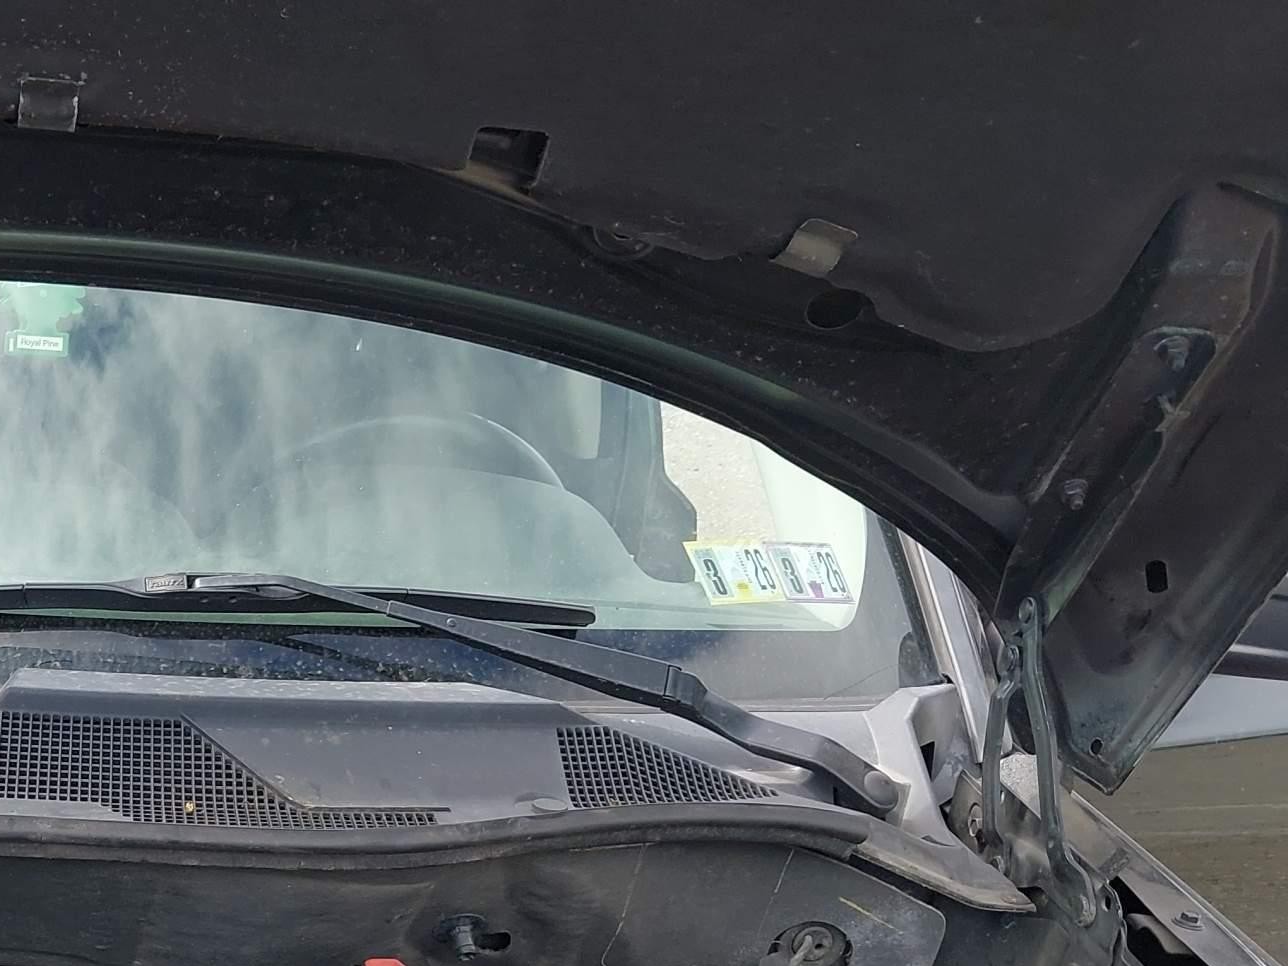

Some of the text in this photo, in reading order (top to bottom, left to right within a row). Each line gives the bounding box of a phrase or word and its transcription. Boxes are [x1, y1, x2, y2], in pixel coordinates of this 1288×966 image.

[20, 335, 60, 348] Royal Pine
[703, 558, 728, 596] 3
[744, 549, 776, 590] 26
[781, 557, 804, 594] 3
[817, 551, 847, 593] 26
